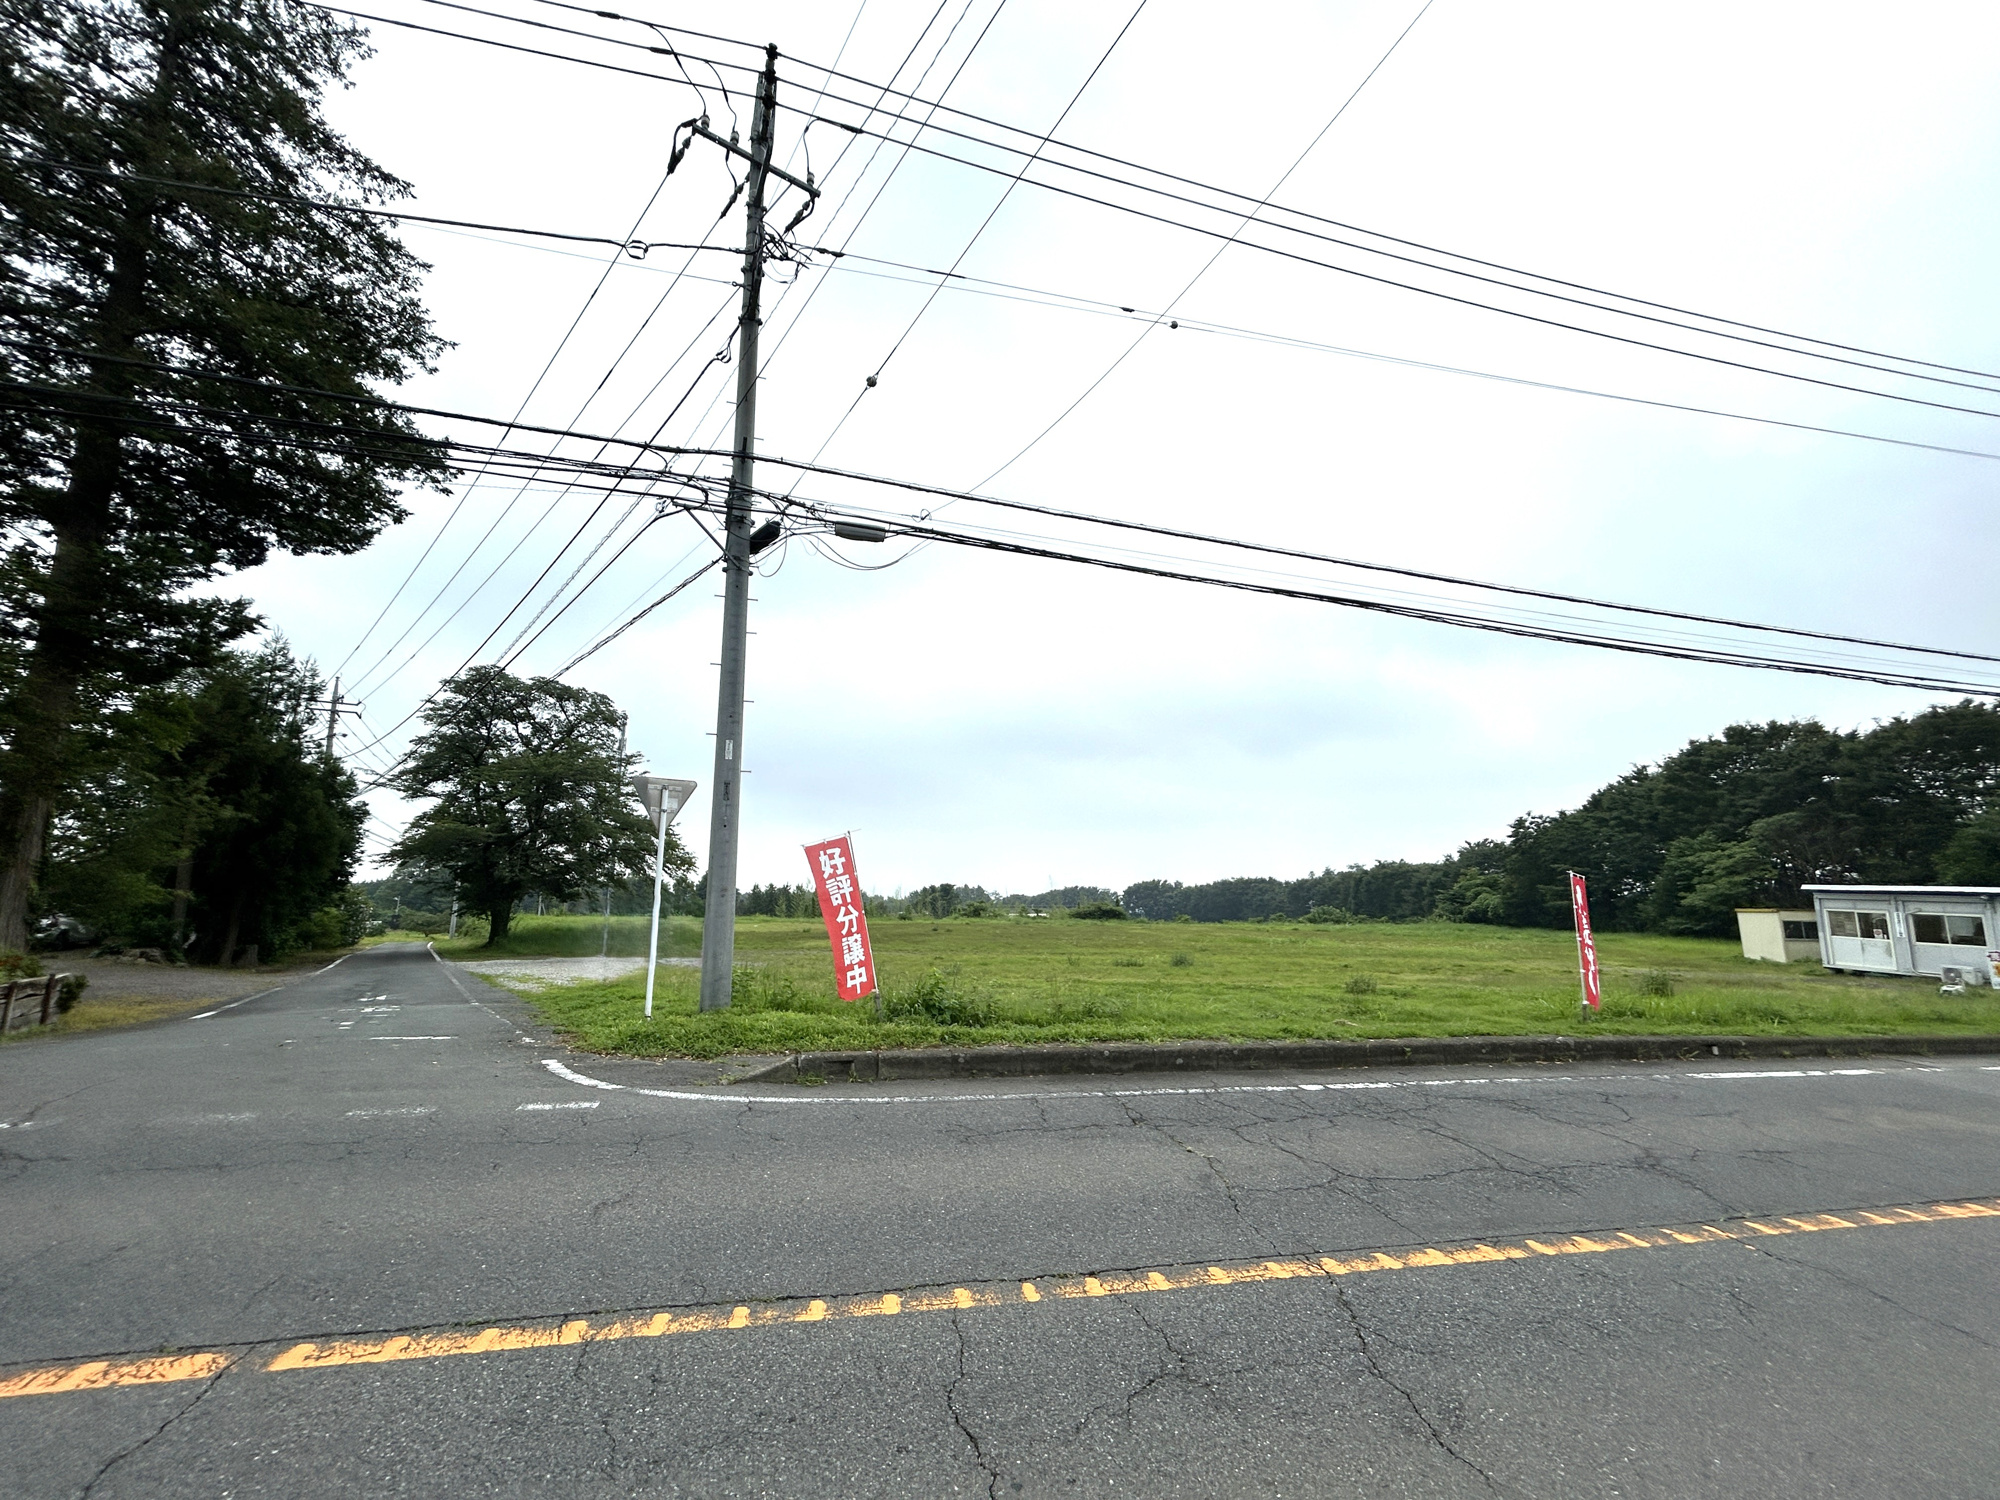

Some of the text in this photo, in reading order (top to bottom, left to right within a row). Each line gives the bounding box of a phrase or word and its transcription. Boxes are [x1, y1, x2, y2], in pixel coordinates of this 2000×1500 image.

[819, 848, 867, 994] 好評分譲中
